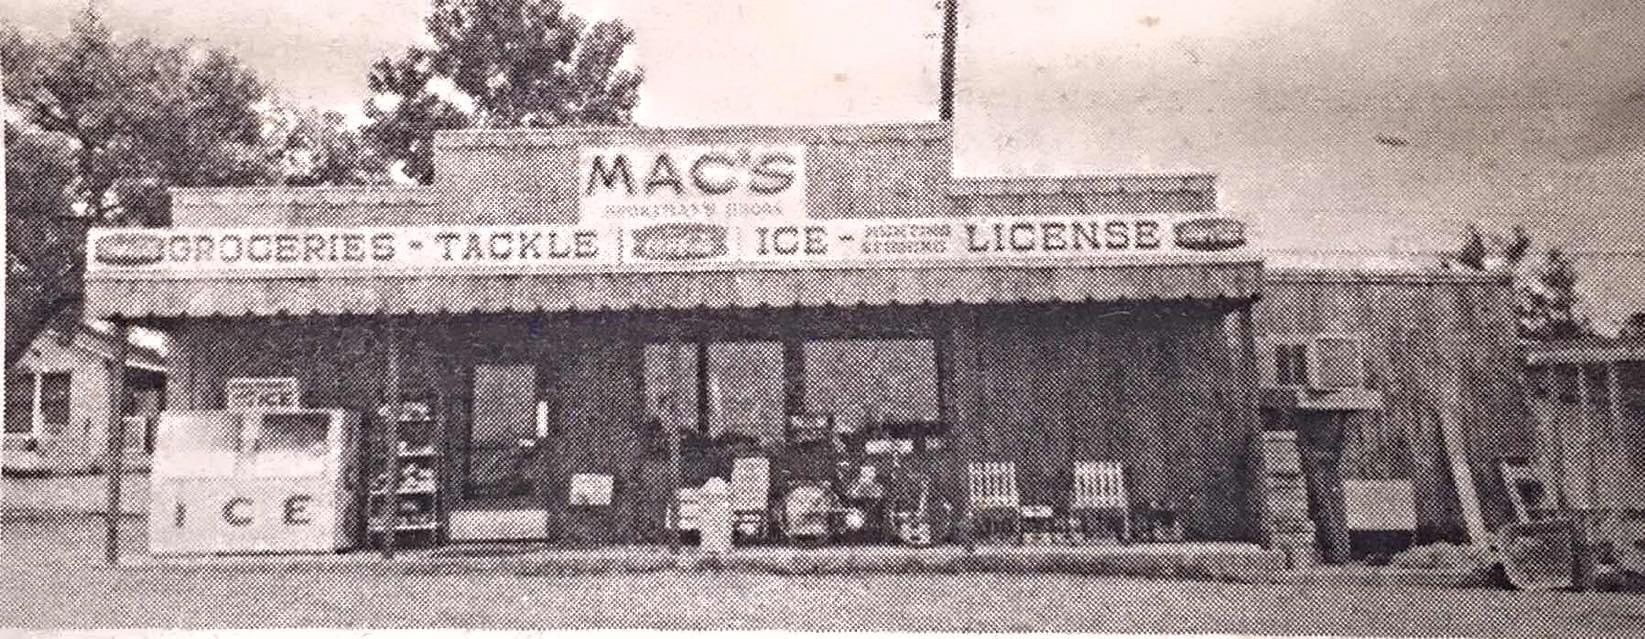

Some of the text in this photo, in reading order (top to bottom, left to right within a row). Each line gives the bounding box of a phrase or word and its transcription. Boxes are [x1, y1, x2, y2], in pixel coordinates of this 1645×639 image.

[585, 150, 797, 197] MAC'S
[168, 233, 396, 263] GROCERIES
[434, 231, 599, 260] TACKLE
[756, 226, 828, 255] ICE
[964, 220, 1160, 251] LICENSE
[175, 494, 313, 528] ICE
